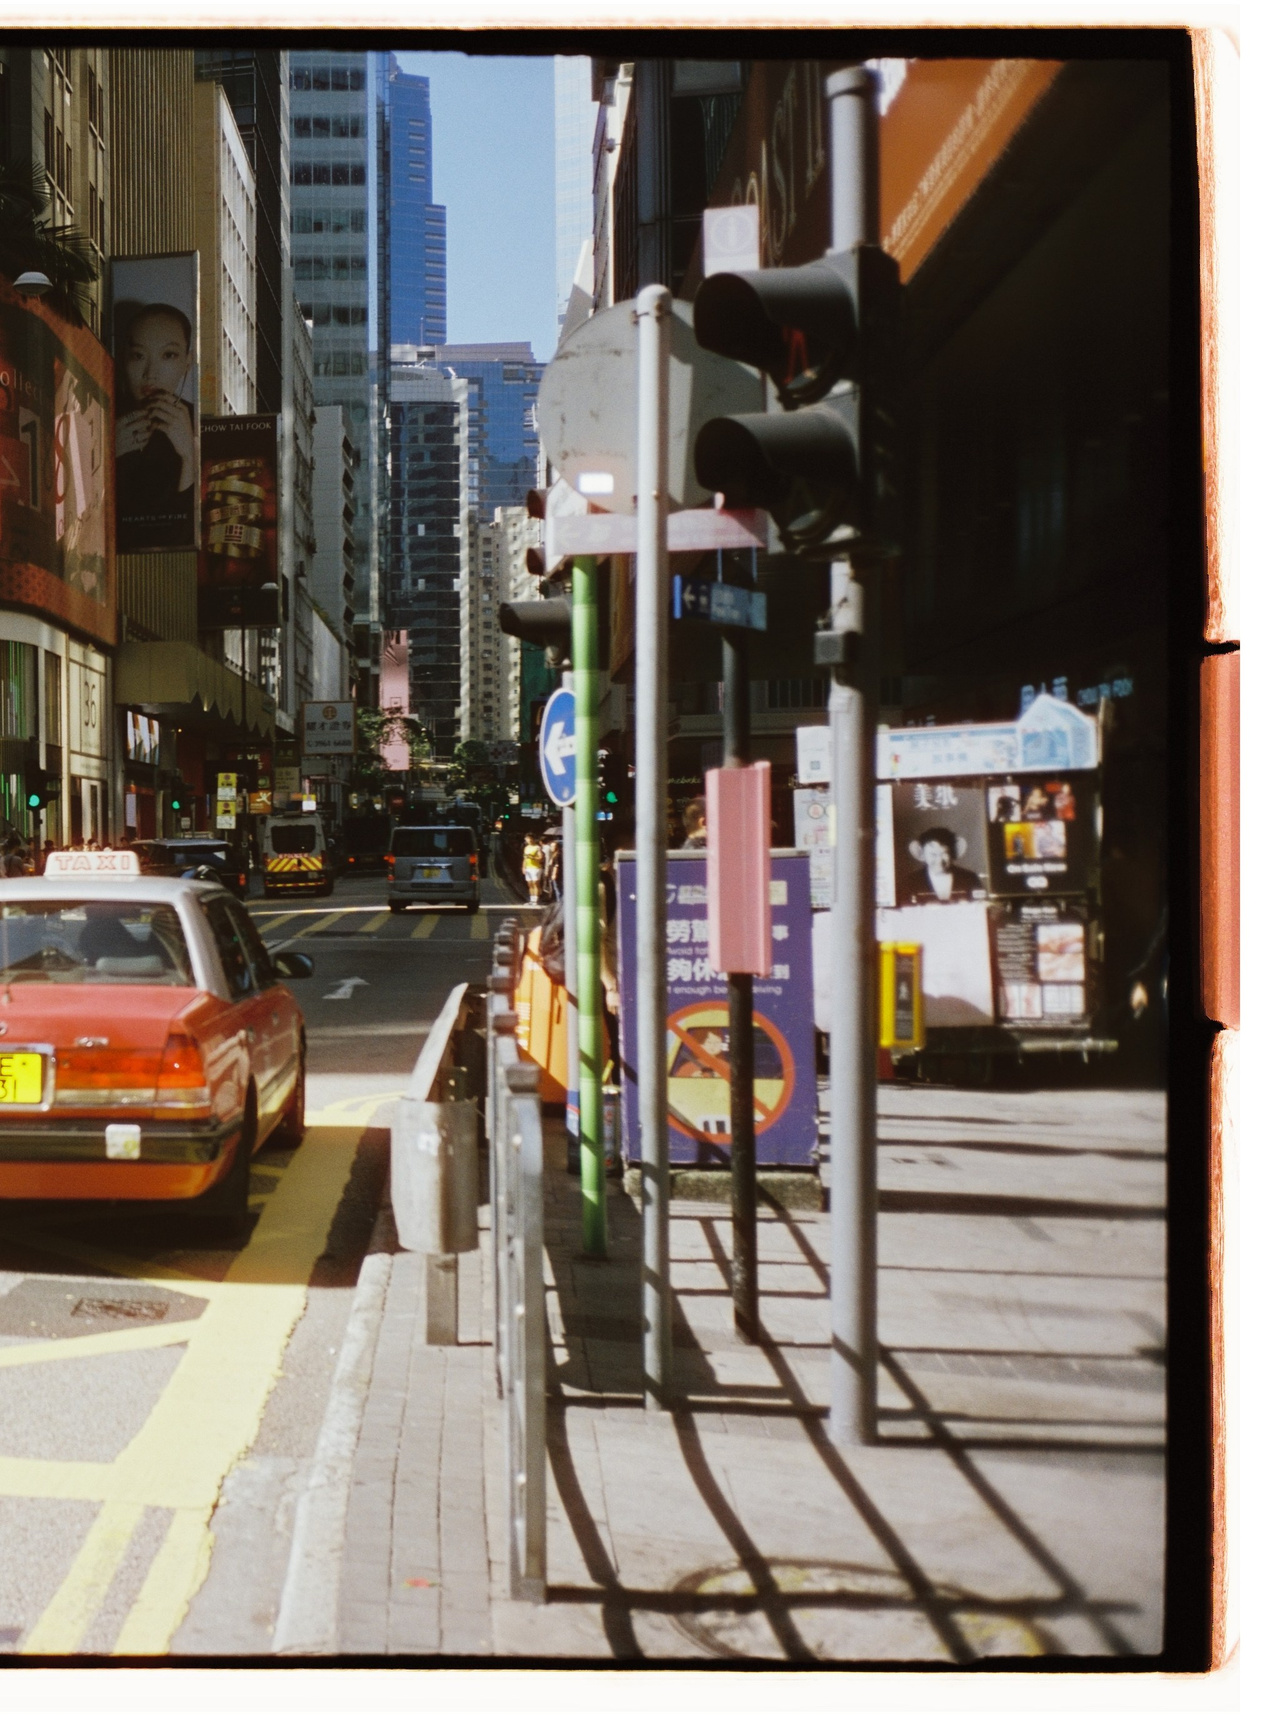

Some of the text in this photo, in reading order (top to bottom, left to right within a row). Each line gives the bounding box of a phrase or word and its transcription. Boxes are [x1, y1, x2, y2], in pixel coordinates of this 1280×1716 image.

[200, 421, 271, 433] CHOW TAI FOOK
[55, 854, 131, 871] TAXI
